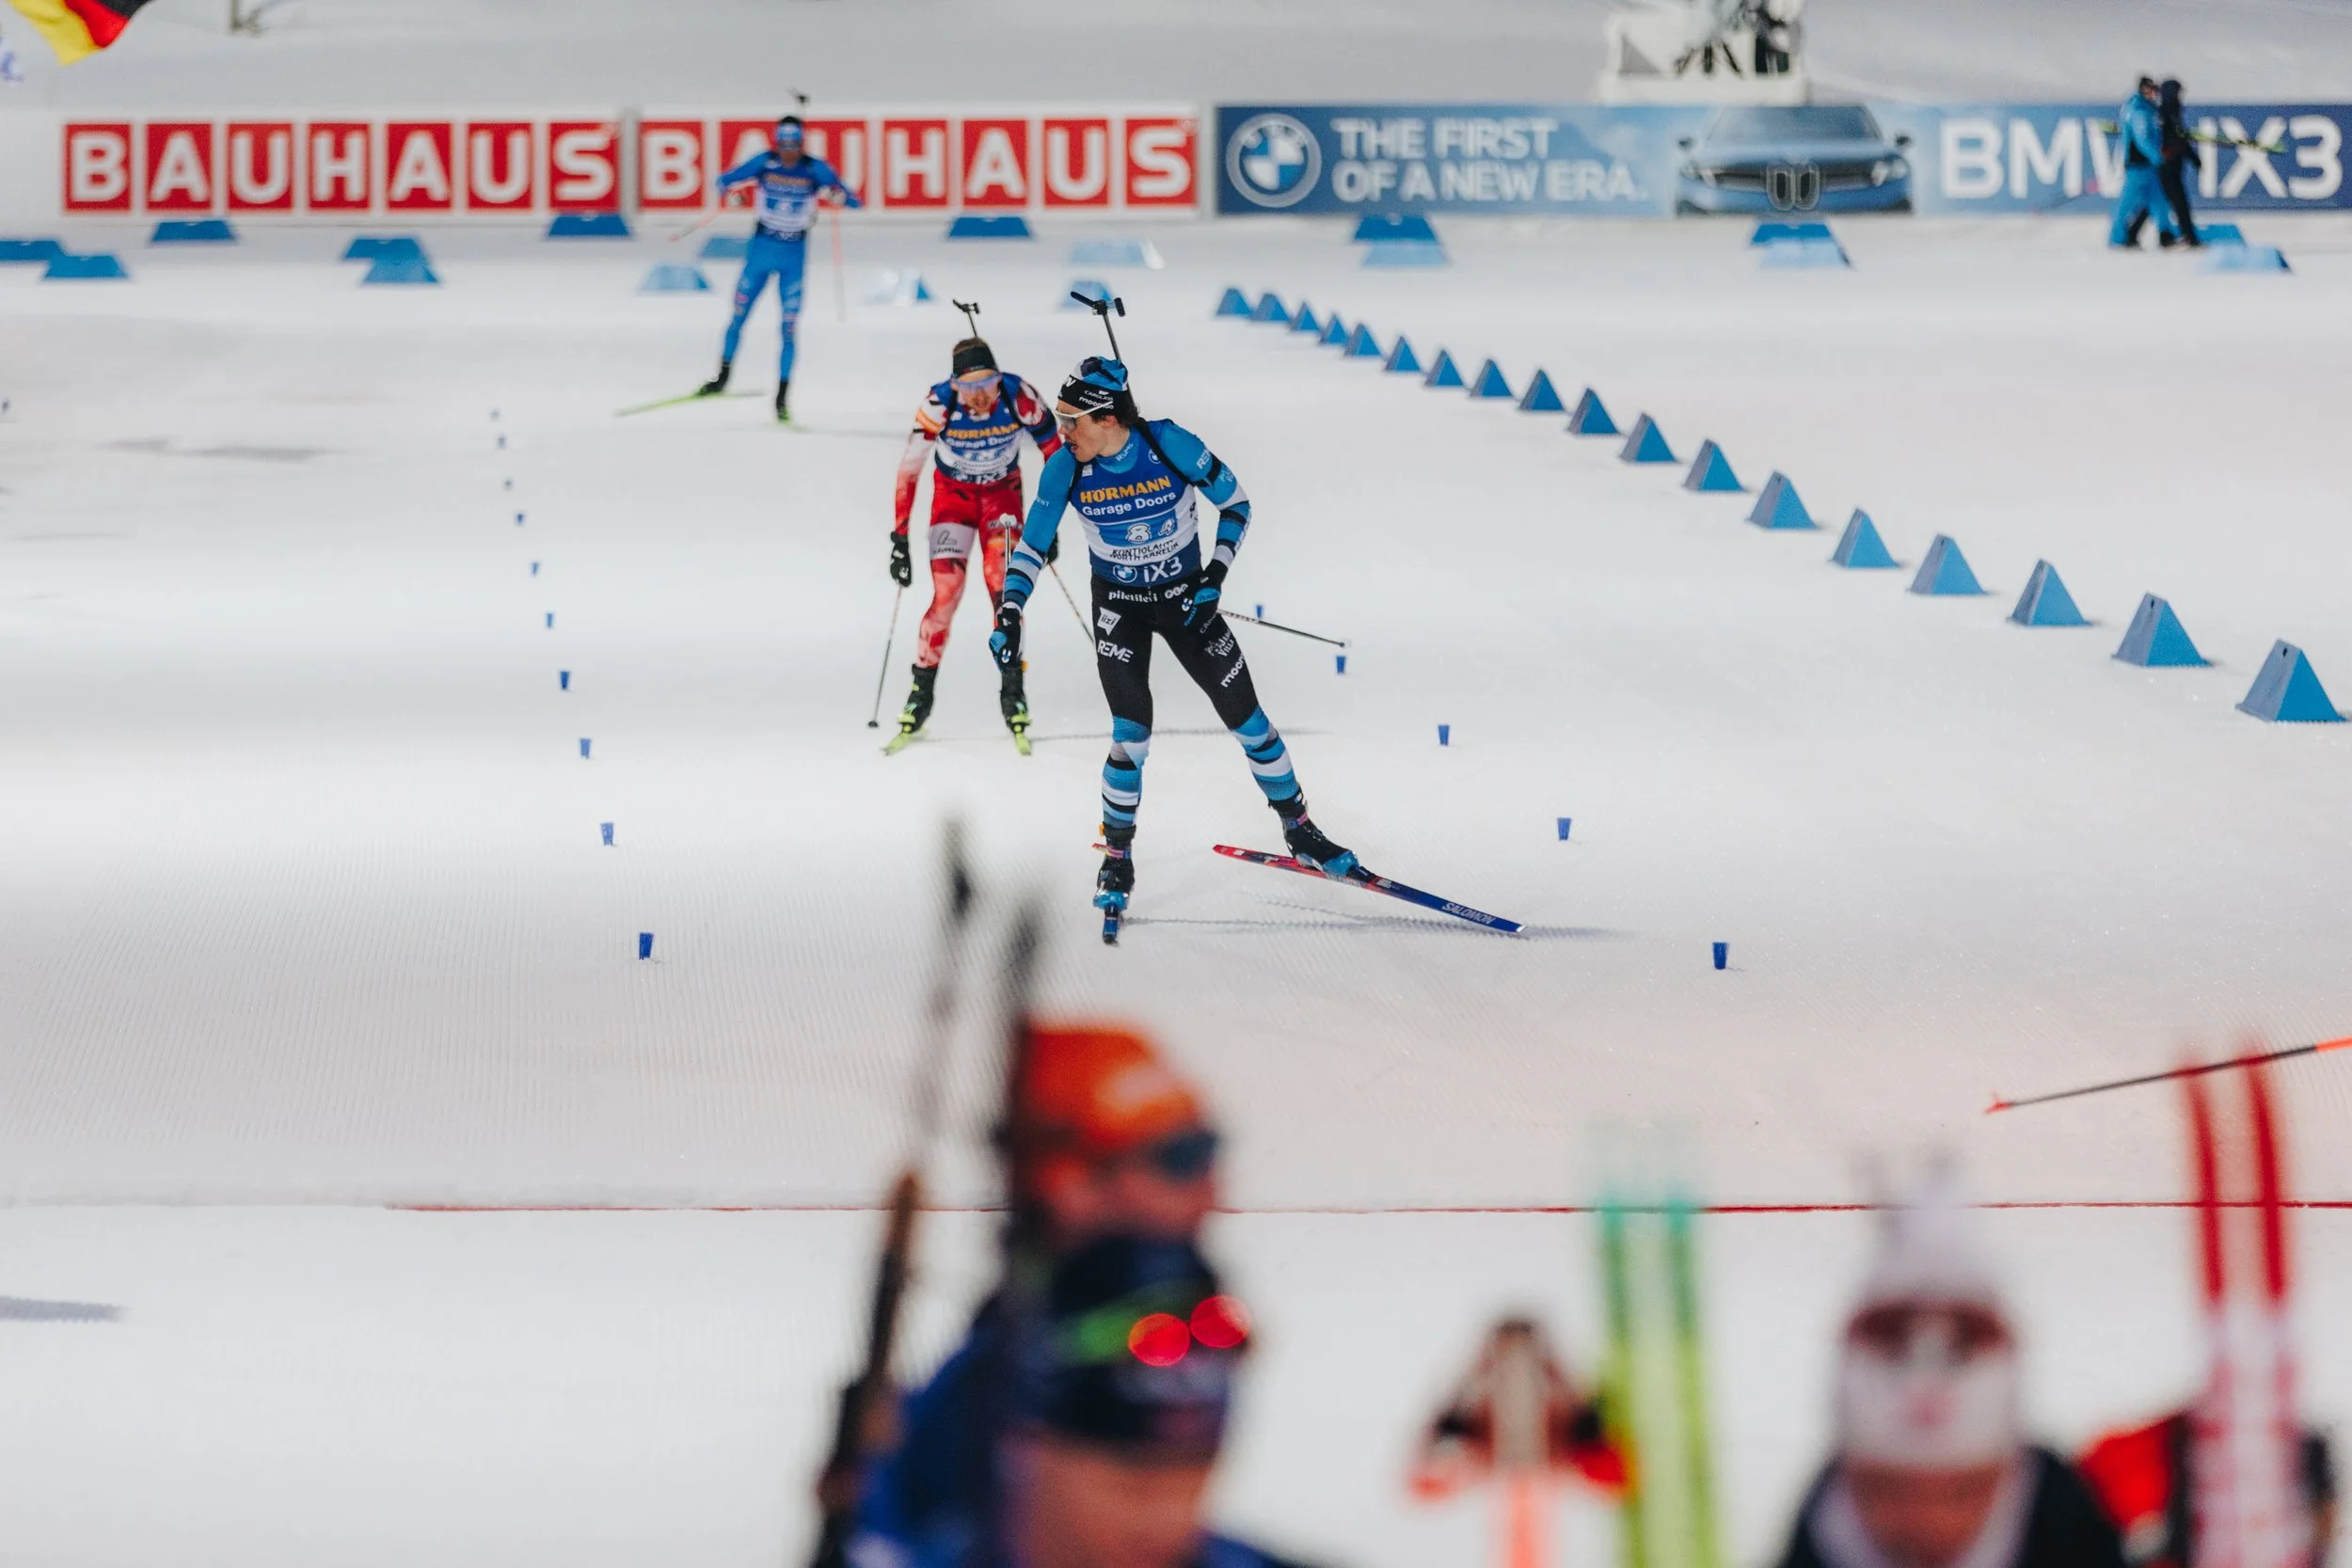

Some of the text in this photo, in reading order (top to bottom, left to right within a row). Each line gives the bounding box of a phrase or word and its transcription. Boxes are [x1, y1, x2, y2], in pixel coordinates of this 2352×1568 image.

[1331, 118, 1425, 159] THE
[1435, 118, 1558, 159] FIRST
[71, 128, 614, 202] BAUHAUS
[1331, 160, 1649, 202] OF A NEW ERA.
[1079, 474, 1171, 504] HÖRMANN
[1082, 491, 1177, 516] Garage Doors
[1143, 556, 1184, 583] iX3
[1097, 639, 1135, 663] REME
[1441, 902, 1497, 925] SALOMON
